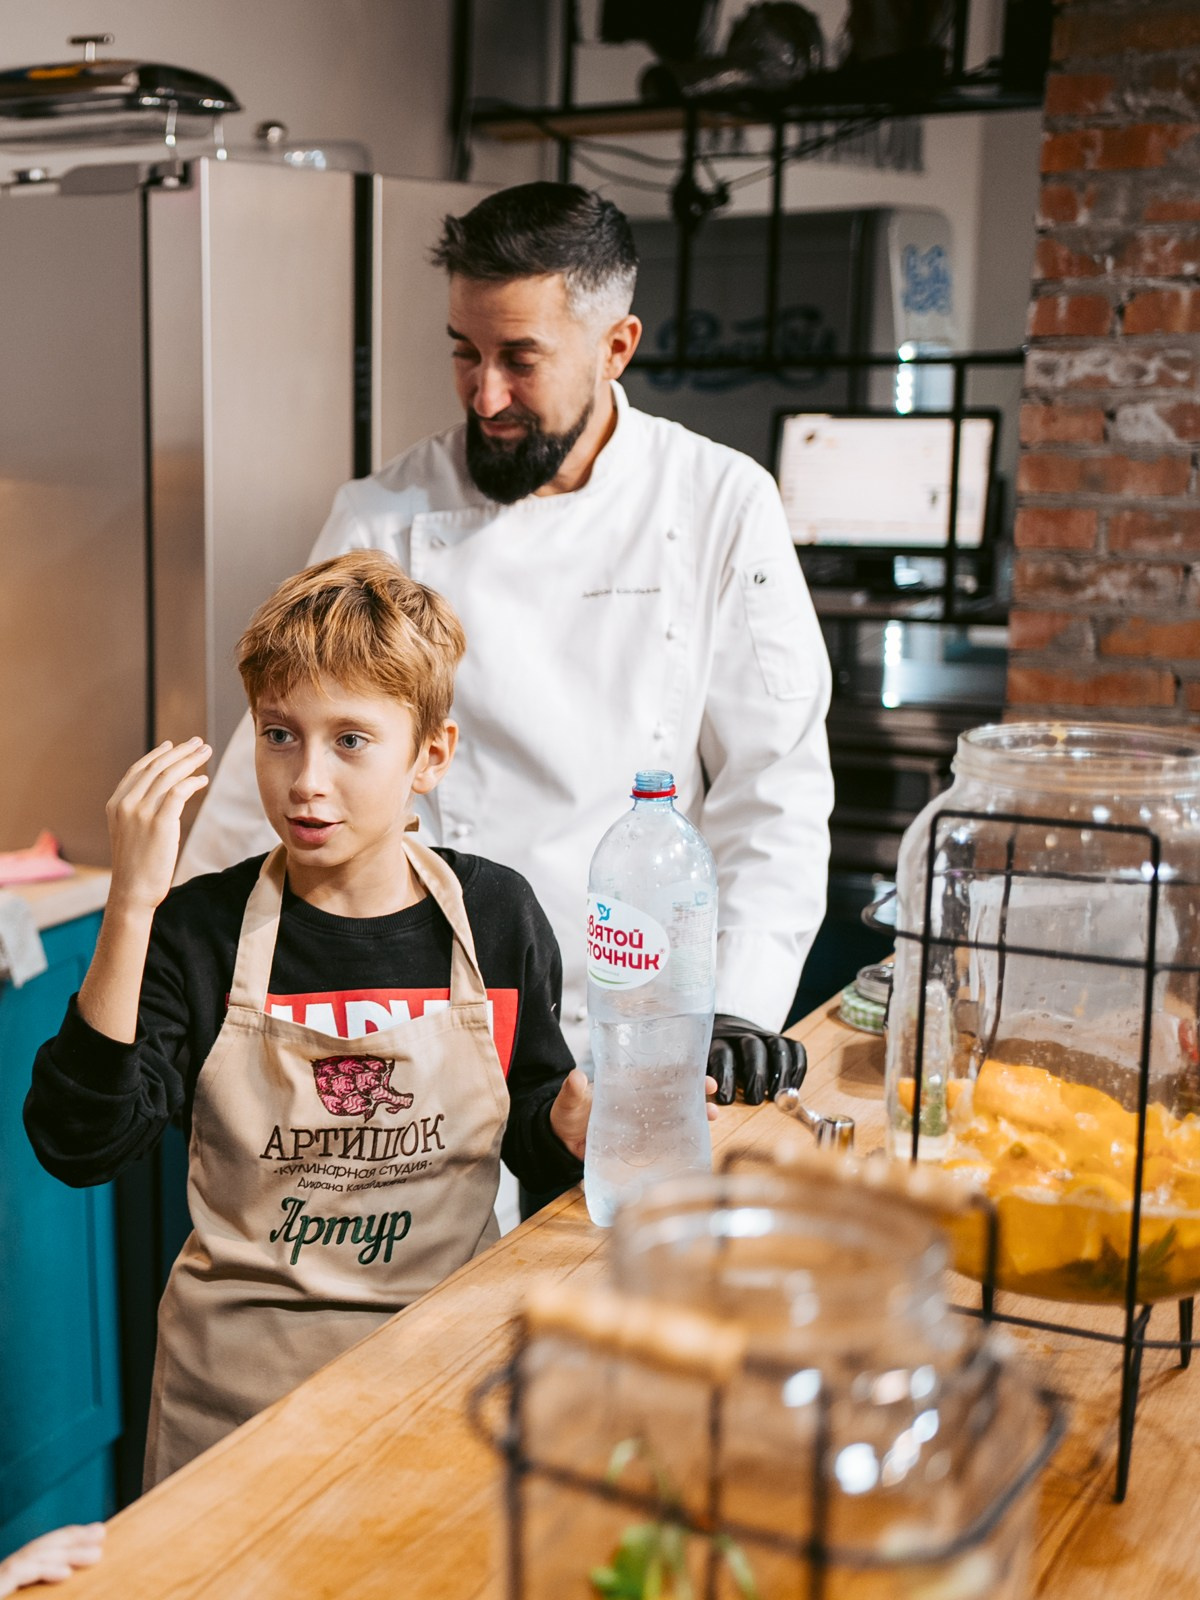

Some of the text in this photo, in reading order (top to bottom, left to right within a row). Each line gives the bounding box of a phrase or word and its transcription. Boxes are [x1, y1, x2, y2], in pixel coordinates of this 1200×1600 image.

[587, 914, 643, 949] вятой
[587, 940, 660, 970] точник
[259, 1113, 446, 1161] АРТИШОК
[269, 1195, 412, 1266] Артур
